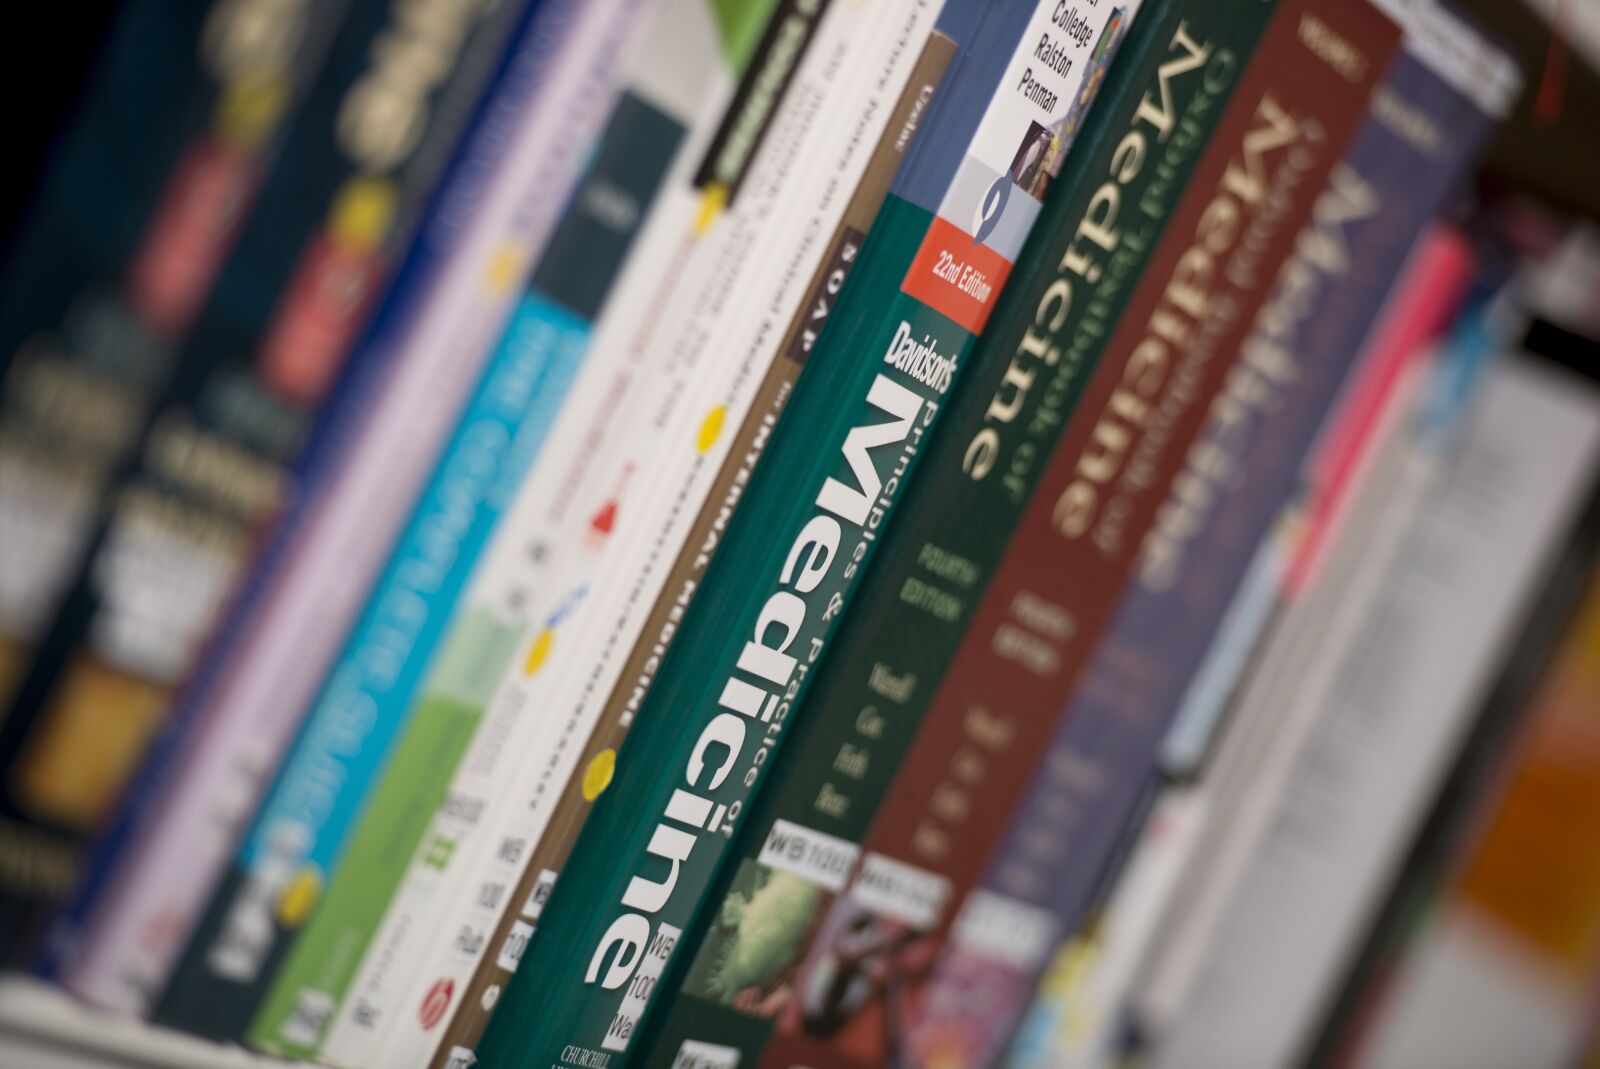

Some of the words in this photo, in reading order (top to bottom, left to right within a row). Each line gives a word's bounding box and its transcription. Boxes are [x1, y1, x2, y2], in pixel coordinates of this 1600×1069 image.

[1034, 33, 1073, 79] Ralston
[1051, 1, 1093, 48] Colledge
[1017, 68, 1058, 114] Penman
[1141, 47, 1238, 217] Oxford
[802, 243, 858, 352] SOAP
[932, 250, 960, 284] 22nd
[956, 267, 991, 304] Edition
[962, 19, 1213, 482] Medicine
[884, 320, 958, 394] Davidson's
[1030, 224, 1150, 436] Textbook
[1049, 92, 1302, 540] Medicine
[692, 412, 777, 571] INTERNAL
[843, 400, 939, 579] Principles
[616, 578, 697, 729] MEDICINE
[822, 591, 844, 622] &
[584, 373, 925, 990] Medicine
[743, 637, 824, 788] Practice
[722, 799, 743, 839] of
[650, 931, 675, 958] WB
[560, 1044, 612, 1069] CHURCHILL
